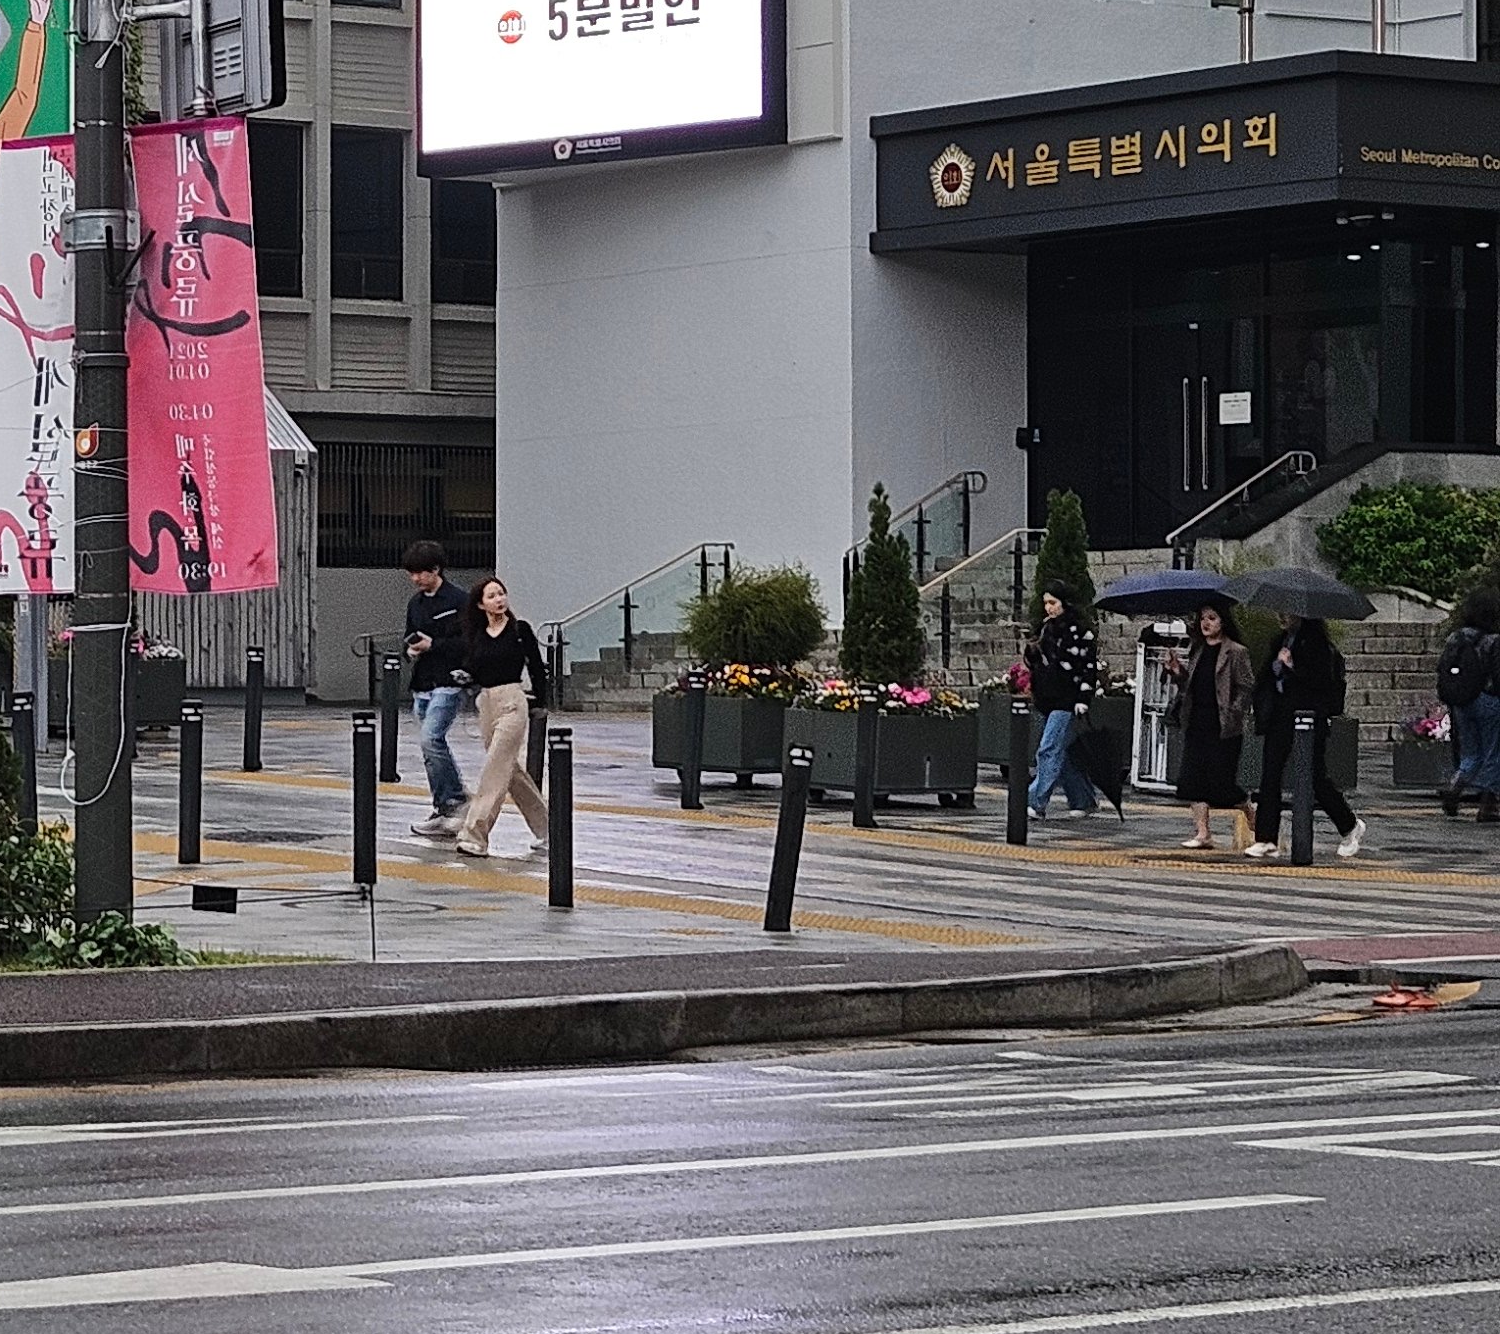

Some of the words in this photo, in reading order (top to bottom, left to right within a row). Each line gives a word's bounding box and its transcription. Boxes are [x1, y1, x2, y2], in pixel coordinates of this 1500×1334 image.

[985, 111, 1278, 190] 서울특별시의회
[1360, 145, 1397, 163] Seoul
[1400, 148, 1480, 168] Metropolitan
